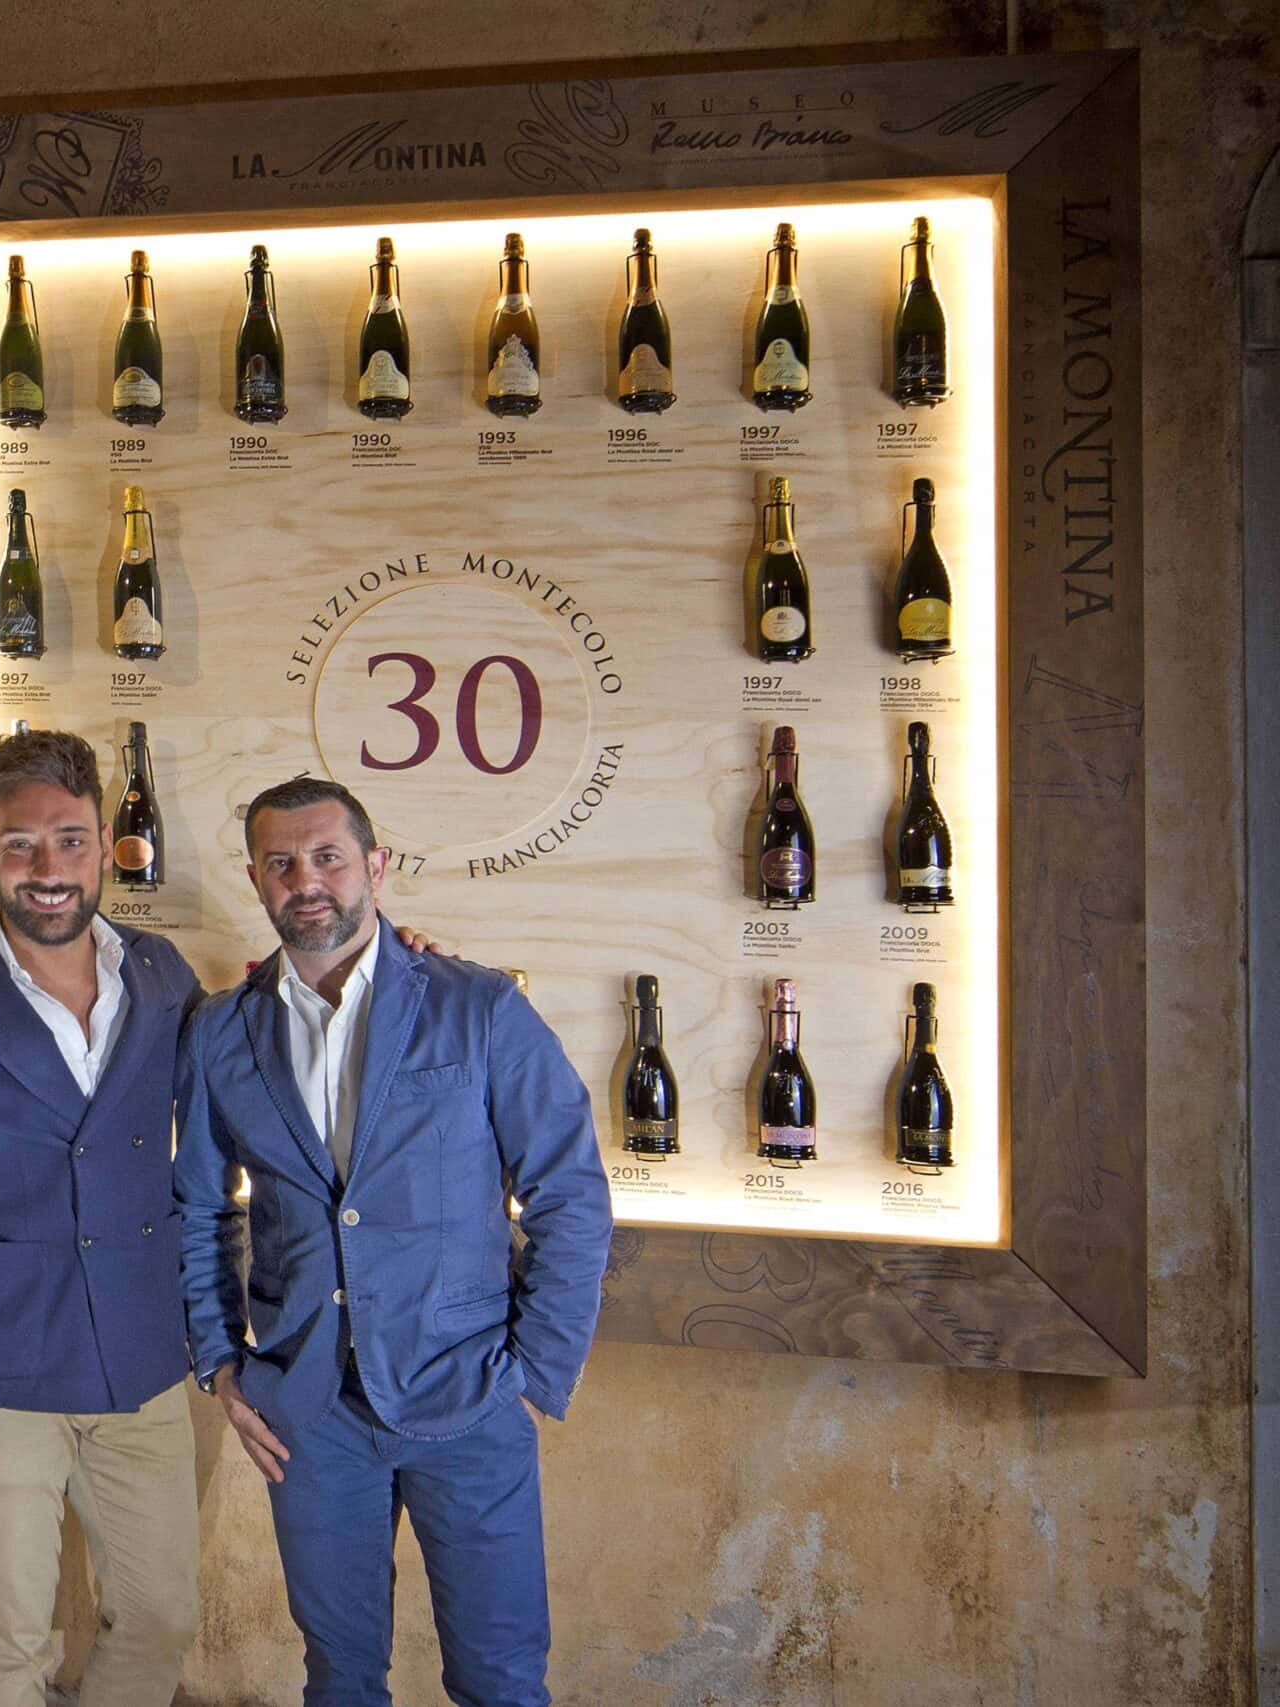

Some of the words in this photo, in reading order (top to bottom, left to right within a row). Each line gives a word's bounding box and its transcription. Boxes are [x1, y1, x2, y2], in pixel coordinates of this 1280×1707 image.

[650, 90, 855, 117] MUSEO
[231, 154, 267, 180] LA
[607, 428, 648, 441] 1996
[740, 425, 781, 439] 1997
[877, 423, 918, 437] 1997
[229, 436, 268, 449] 1990
[351, 433, 392, 446] 1990
[478, 431, 517, 444] 1993
[110, 439, 146, 452] 1989
[1041, 287, 1116, 627] MONTINA
[286, 553, 431, 685] SELEZIONE
[462, 551, 622, 695] MONTECOLO
[111, 673, 146, 685] 1997
[743, 676, 783, 689] 1997
[879, 677, 921, 690] 1998
[360, 651, 543, 776] 30
[467, 742, 624, 879] FRANCIACORTA
[110, 902, 151, 915] 2002
[743, 922, 790, 935] 2003
[880, 926, 928, 940] 2009
[611, 1166, 651, 1181] 2015
[744, 1174, 785, 1188] 2015
[881, 1181, 925, 1196] 2016
